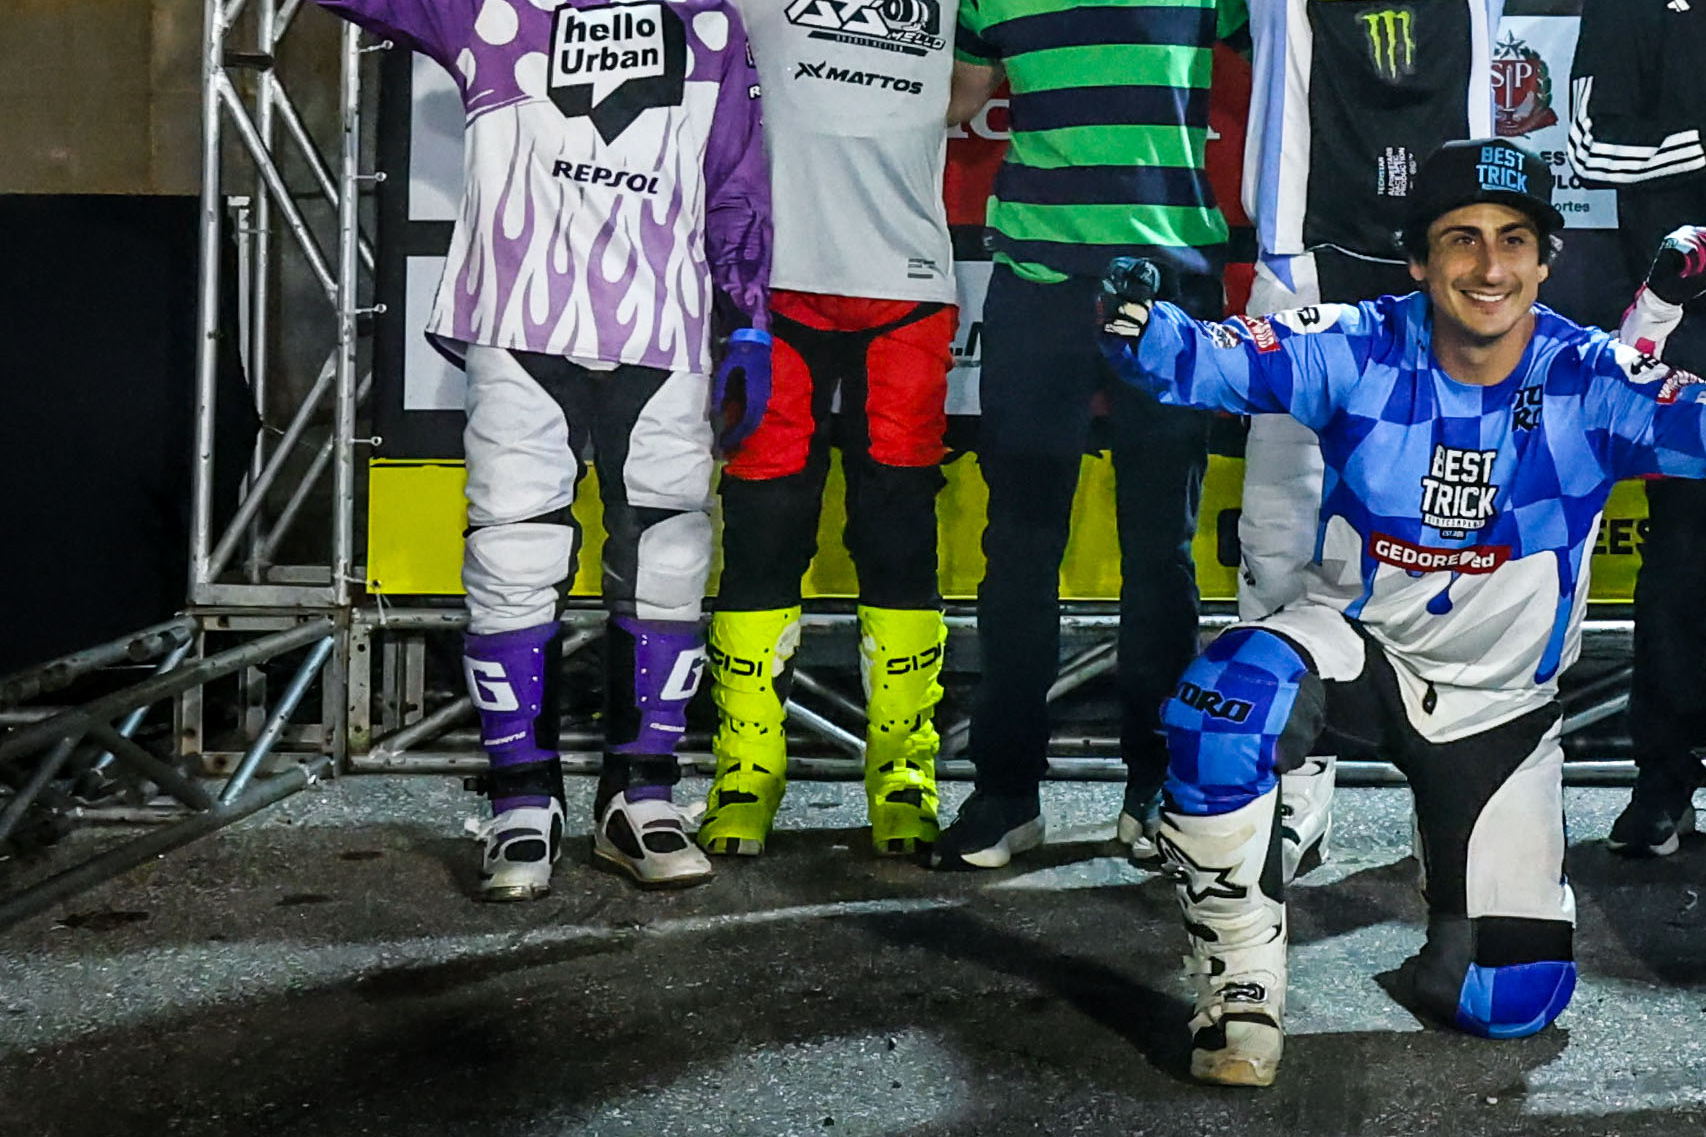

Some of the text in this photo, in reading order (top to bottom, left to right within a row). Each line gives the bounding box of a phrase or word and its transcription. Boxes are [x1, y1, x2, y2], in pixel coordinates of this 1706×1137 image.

[564, 12, 657, 44] hello
[560, 46, 660, 75] Urban
[1480, 146, 1526, 171] BEST
[552, 160, 660, 195] REPSOL
[1476, 164, 1528, 193] TRICK
[1554, 201, 1590, 212] ortes
[1432, 445, 1497, 484] BEST
[1422, 478, 1497, 519] TRICK
[1178, 682, 1256, 724] ORO
